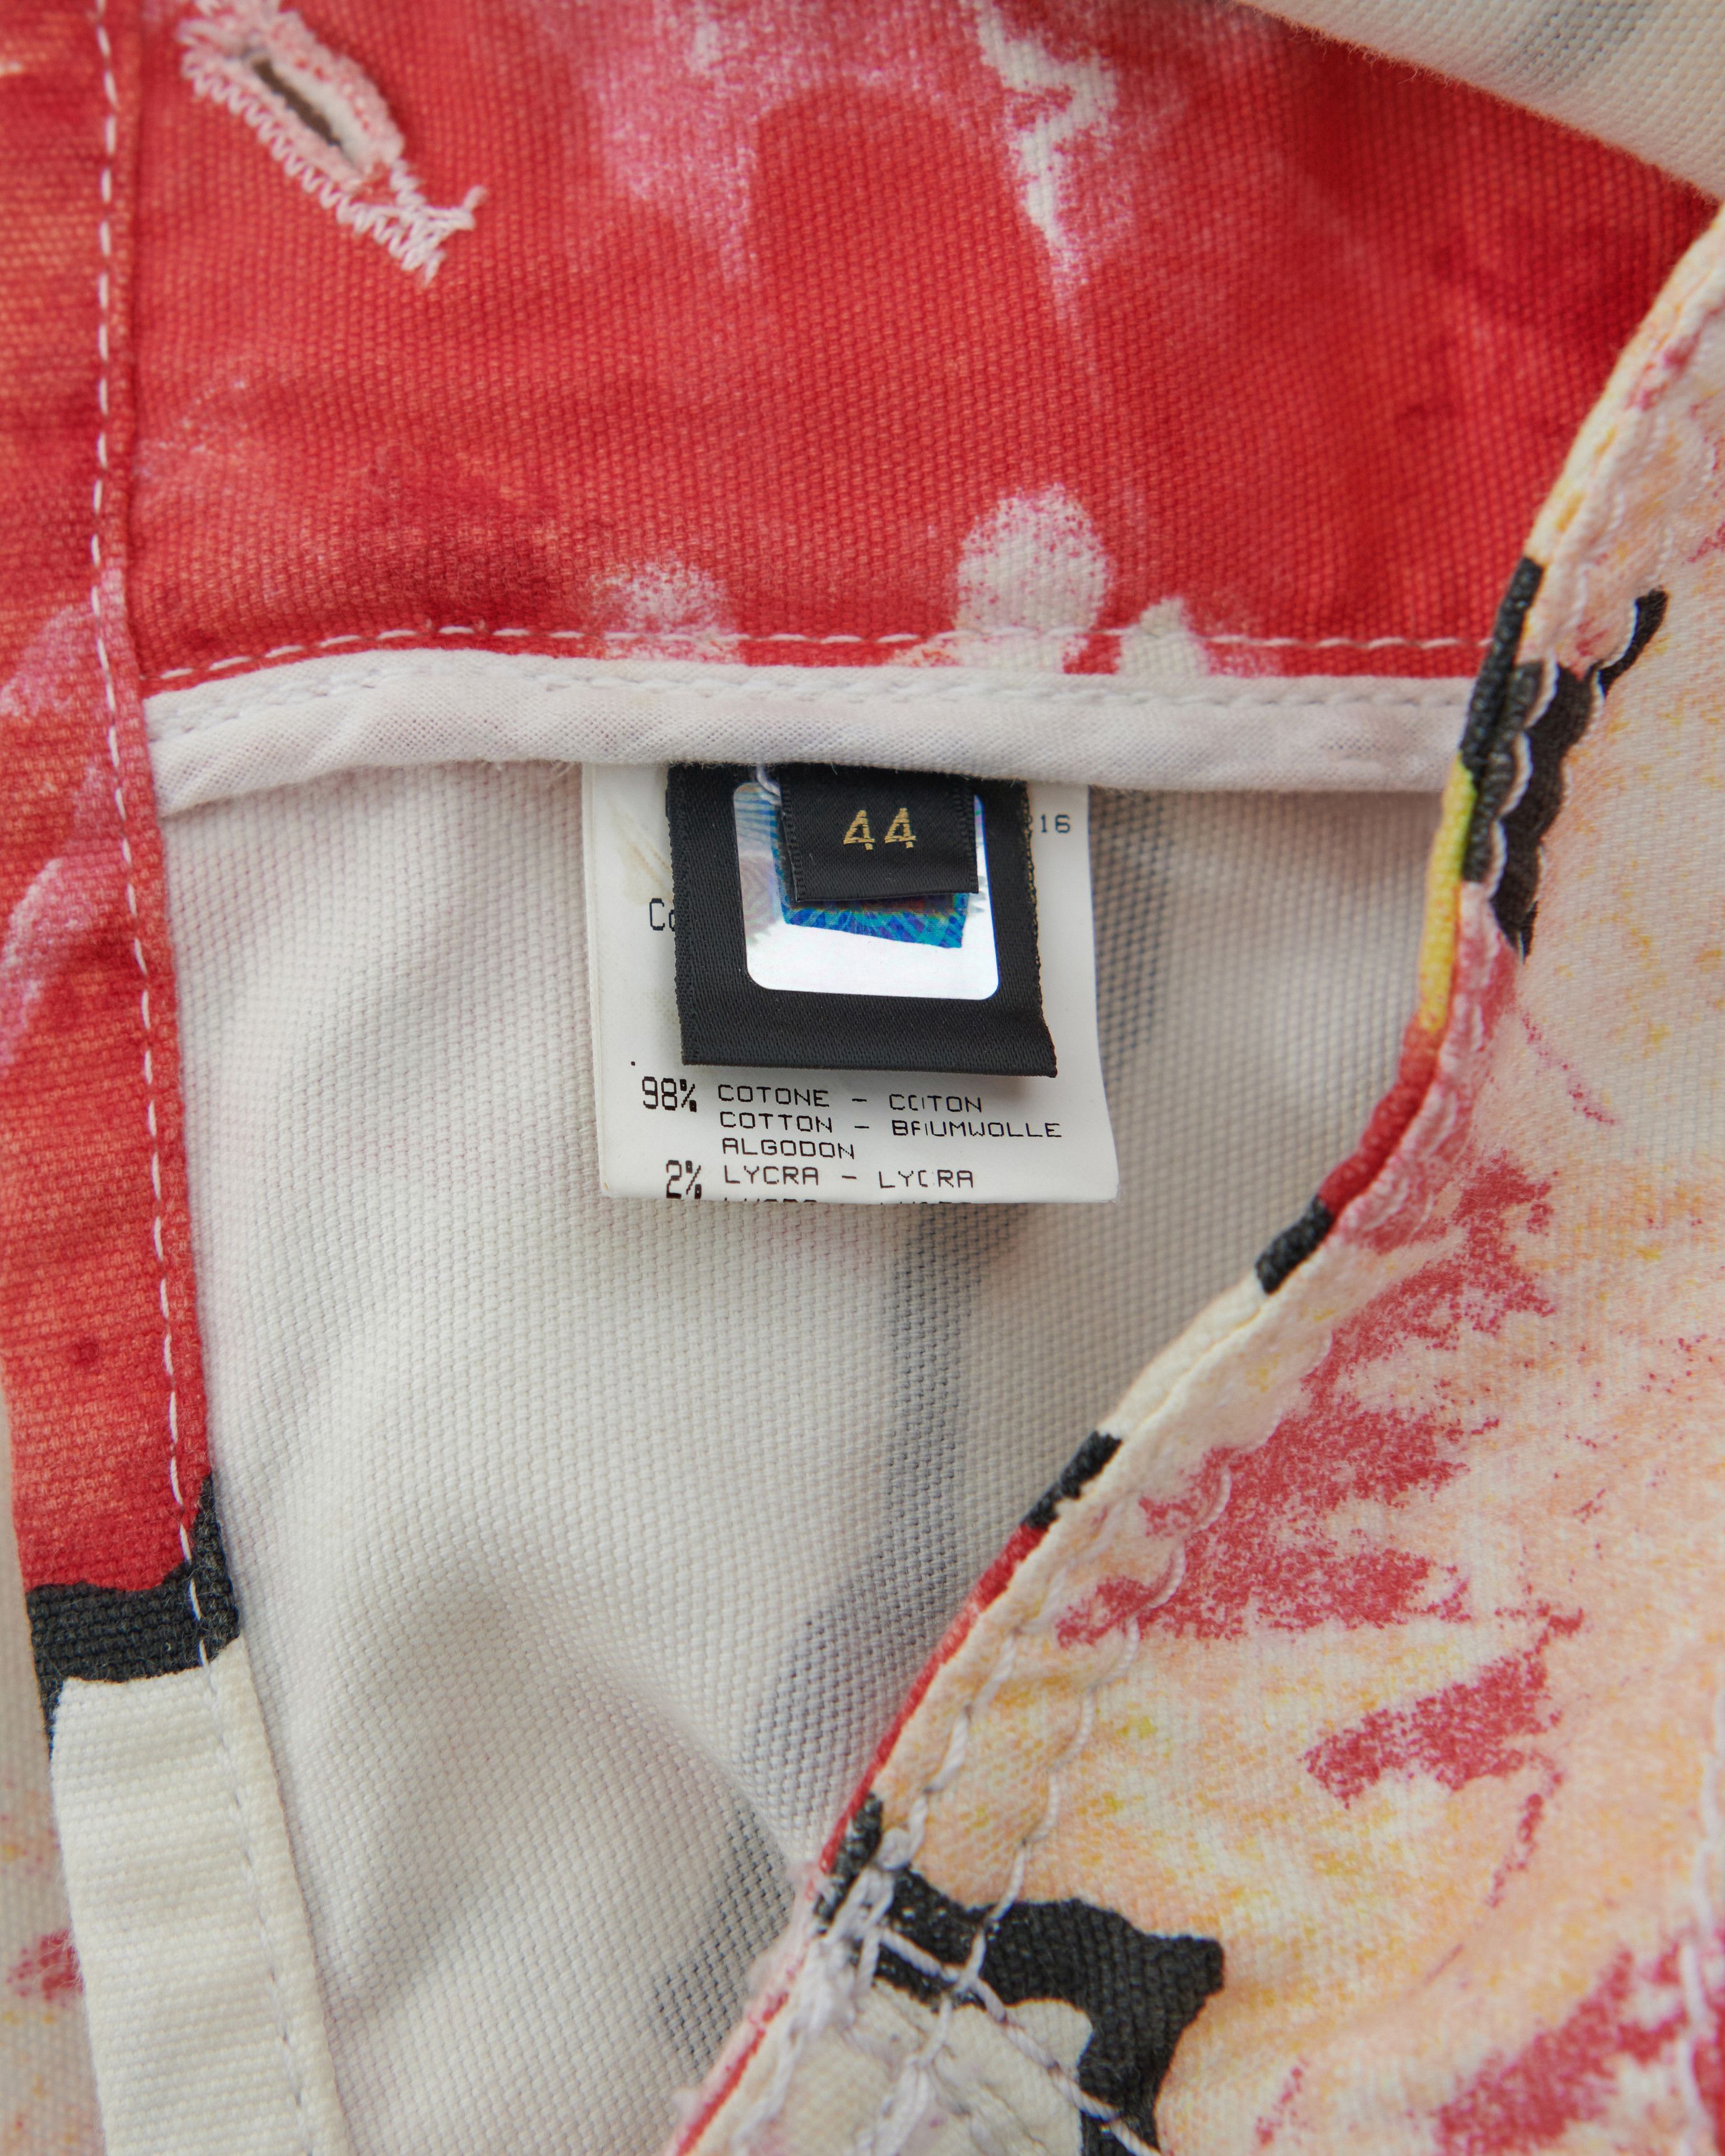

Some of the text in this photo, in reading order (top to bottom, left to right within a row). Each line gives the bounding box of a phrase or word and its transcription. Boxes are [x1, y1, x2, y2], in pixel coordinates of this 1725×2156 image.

[843, 807, 917, 851] 44
[641, 1076, 697, 1113] 98%
[718, 1084, 830, 1108] COTONE
[720, 1111, 833, 1133] COTTON
[891, 1119, 1063, 1138] BAUMWOLLE
[721, 1137, 855, 1160] ALGODON
[665, 1159, 702, 1200] 2%
[724, 1164, 819, 1186] LYCRA
[878, 1169, 975, 1189] LYCRA
